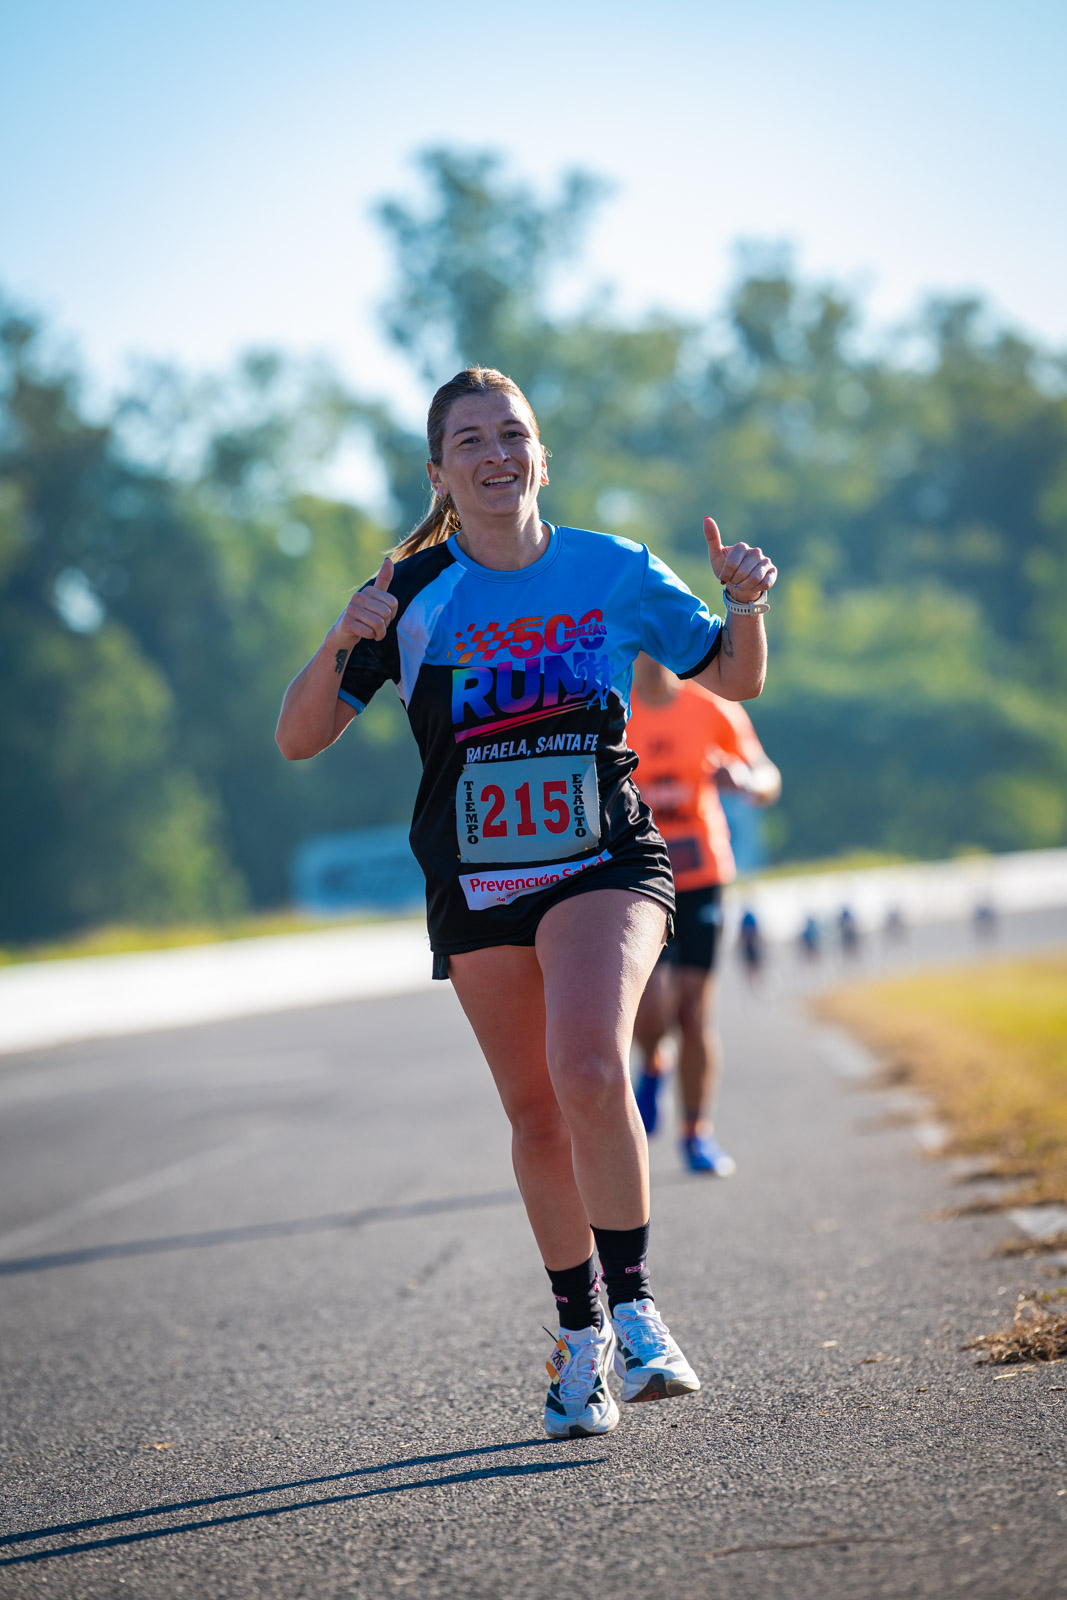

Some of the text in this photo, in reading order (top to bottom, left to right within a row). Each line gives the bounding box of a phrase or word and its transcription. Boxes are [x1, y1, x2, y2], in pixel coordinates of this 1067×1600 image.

[564, 624, 607, 640] MILLAS
[452, 652, 598, 725] RUN
[466, 734, 598, 763] RAFAELA, SANTA FE
[464, 781, 479, 844] TIEMPO
[480, 780, 570, 838] 215
[572, 774, 586, 837] EXACTO
[469, 873, 560, 892] Prevención
